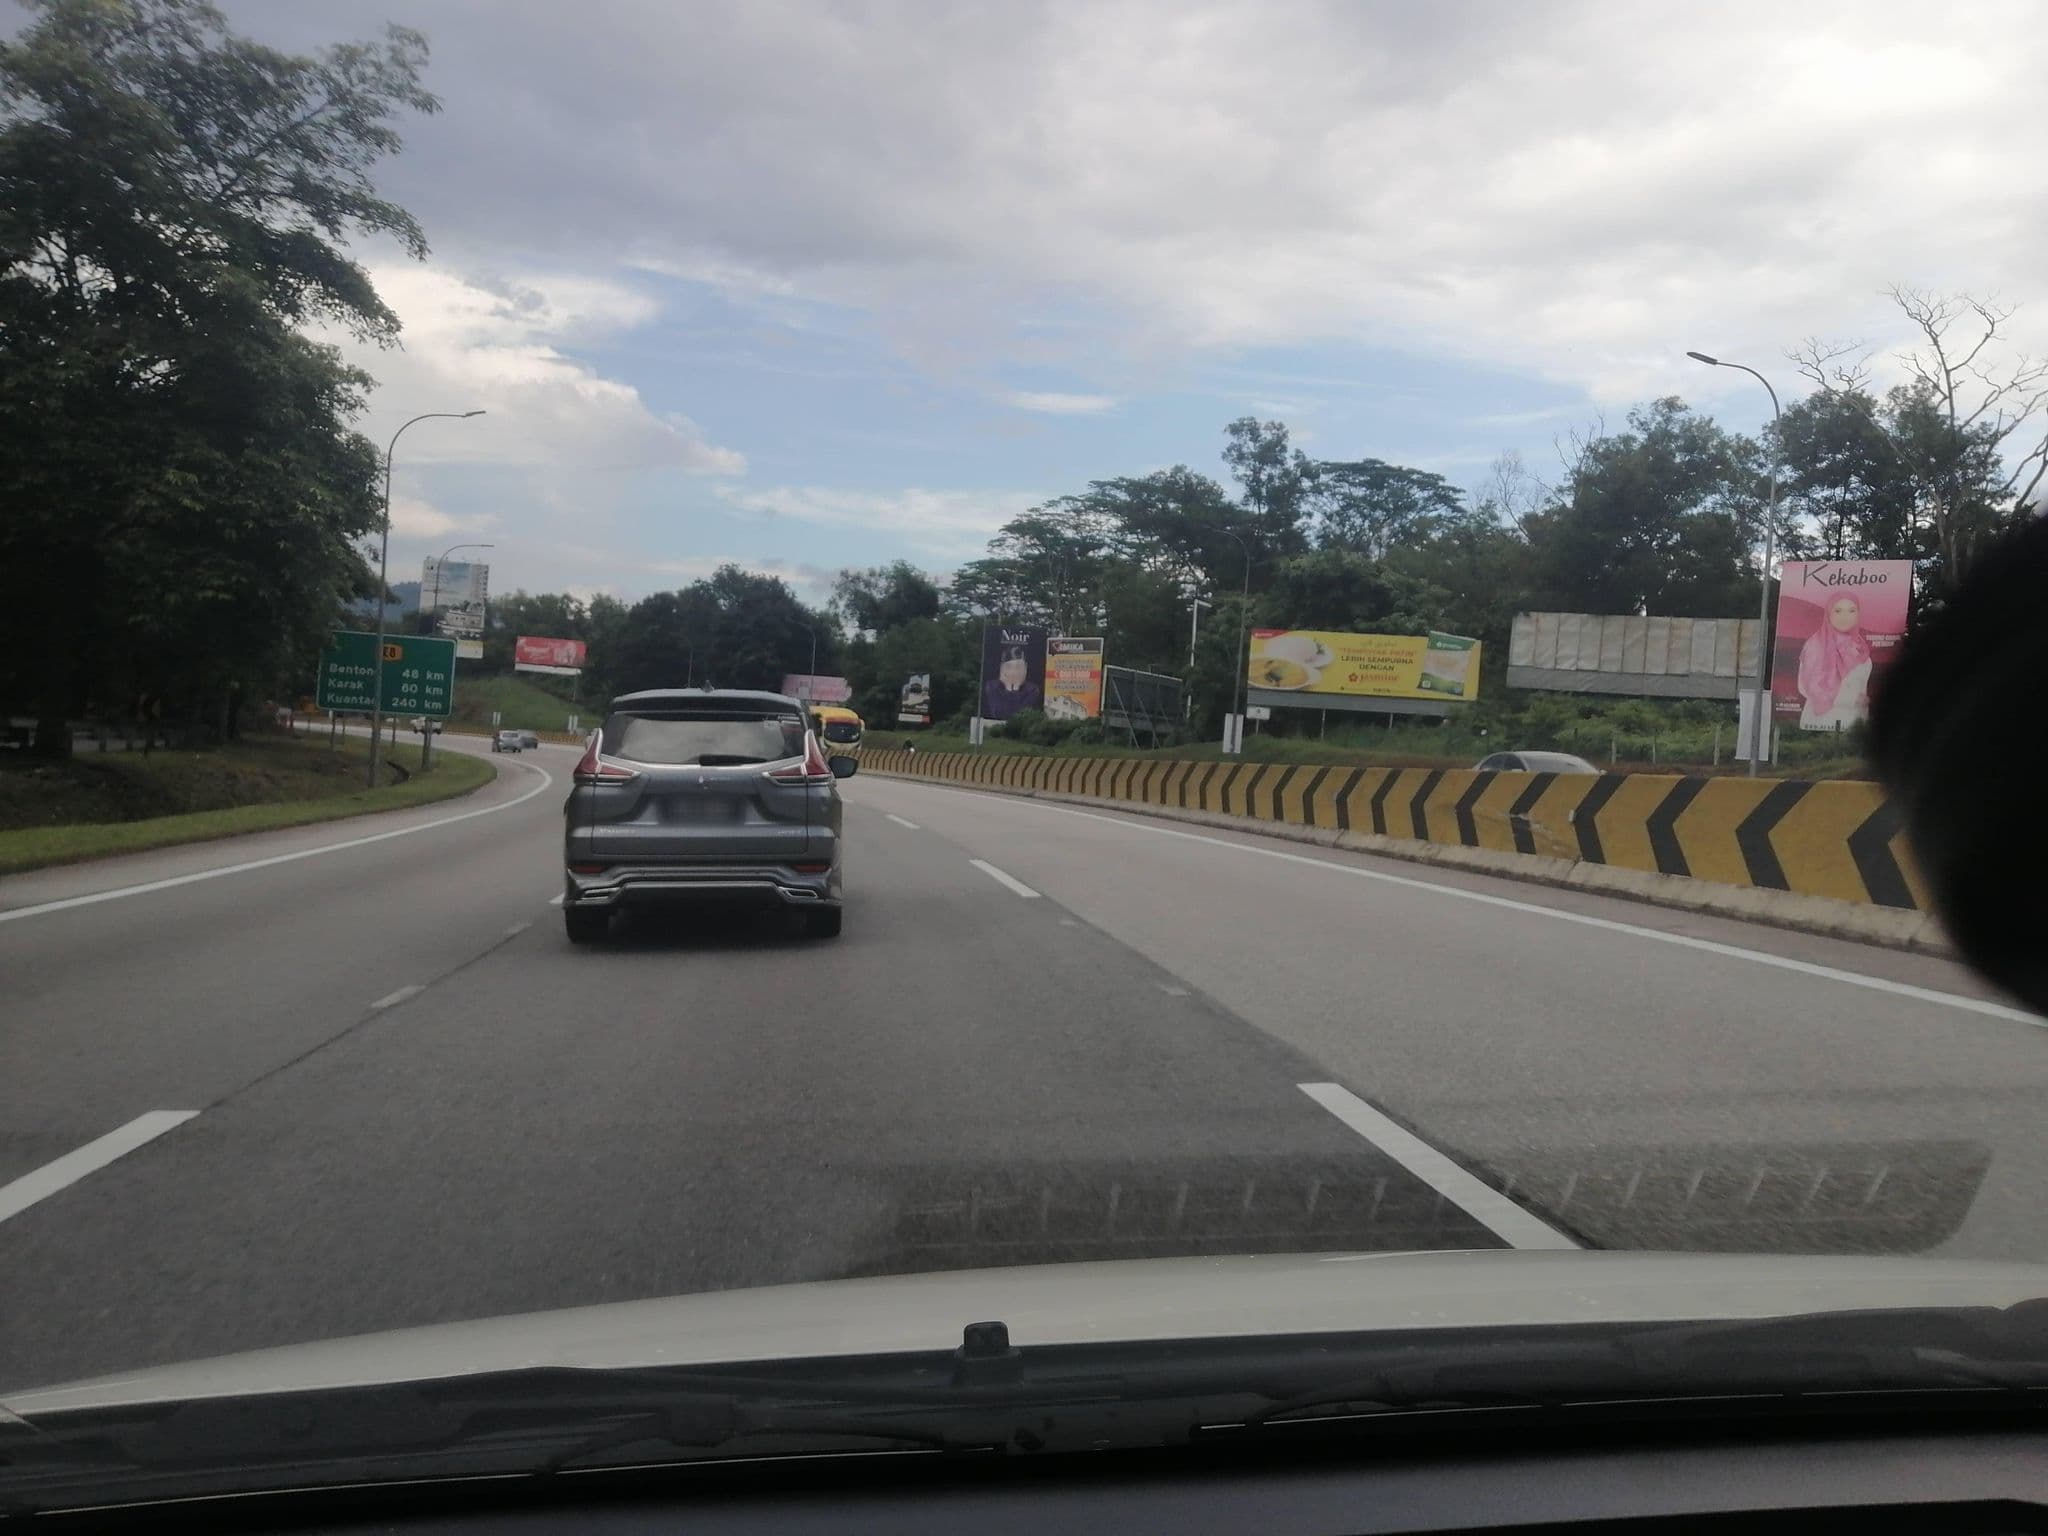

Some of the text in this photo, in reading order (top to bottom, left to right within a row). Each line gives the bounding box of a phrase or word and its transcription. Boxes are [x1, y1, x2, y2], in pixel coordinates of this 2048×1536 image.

[1803, 563, 1887, 587] Kekaboo
[1001, 629, 1030, 641] Noir
[1341, 655, 1414, 665] LEBIH SEMPURNA
[329, 663, 444, 681] Benton 48 km
[328, 678, 443, 696] Karak 60 km
[391, 697, 417, 708] 240
[424, 699, 442, 709] km
